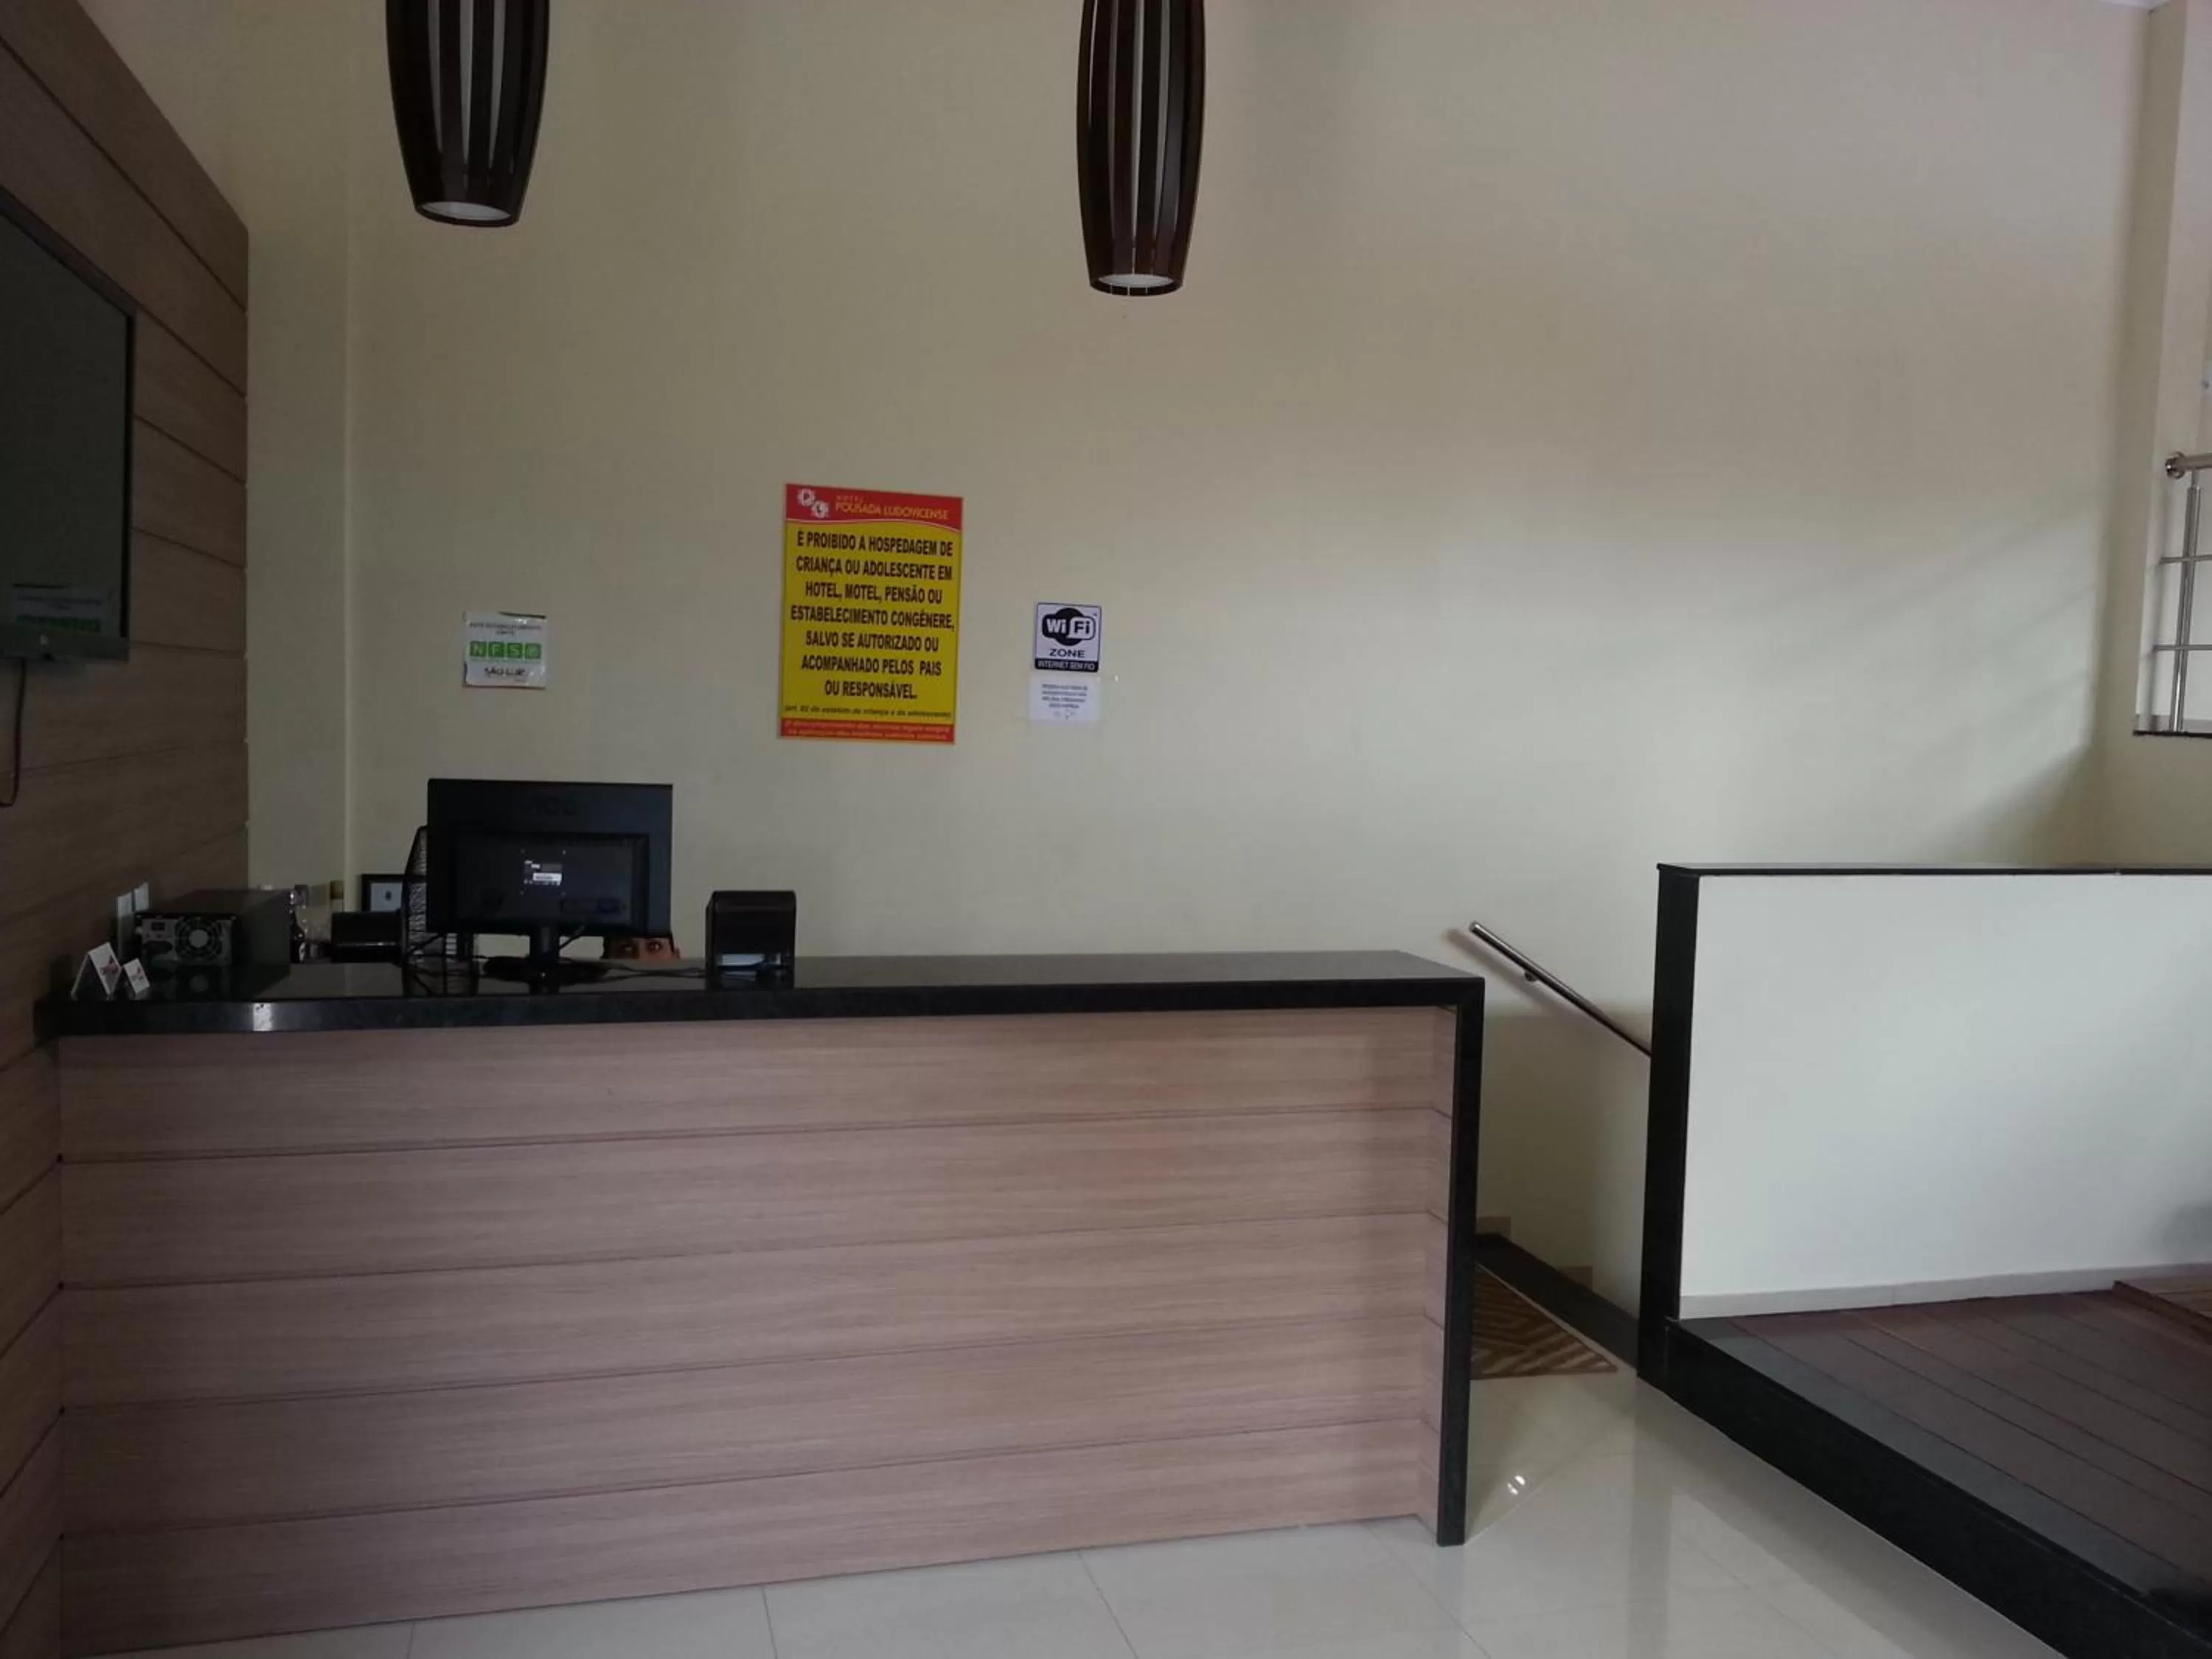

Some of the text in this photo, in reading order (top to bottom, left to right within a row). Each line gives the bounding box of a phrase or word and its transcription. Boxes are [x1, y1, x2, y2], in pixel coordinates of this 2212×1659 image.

[835, 502, 950, 520] POUSADA LUDOVICENSE
[807, 532, 856, 549] PROIBIDO
[858, 535, 866, 551] A
[869, 536, 937, 556] HOSPEDAGEM
[940, 541, 953, 557] DE
[796, 557, 952, 580] CRIANÇA OU ADOLESCENTE EM
[805, 581, 942, 604] HOTEL, MOTEL, PENSÃO OU
[791, 605, 888, 626] ESTABELECIMENTO
[806, 630, 939, 652] SALVO SE AUTORIZADO OU
[1049, 648, 1085, 658] ZONE
[801, 655, 942, 676] ACOMPANHADO PELOS PAIS
[824, 680, 918, 699] OU RESPONSÁVEL.
